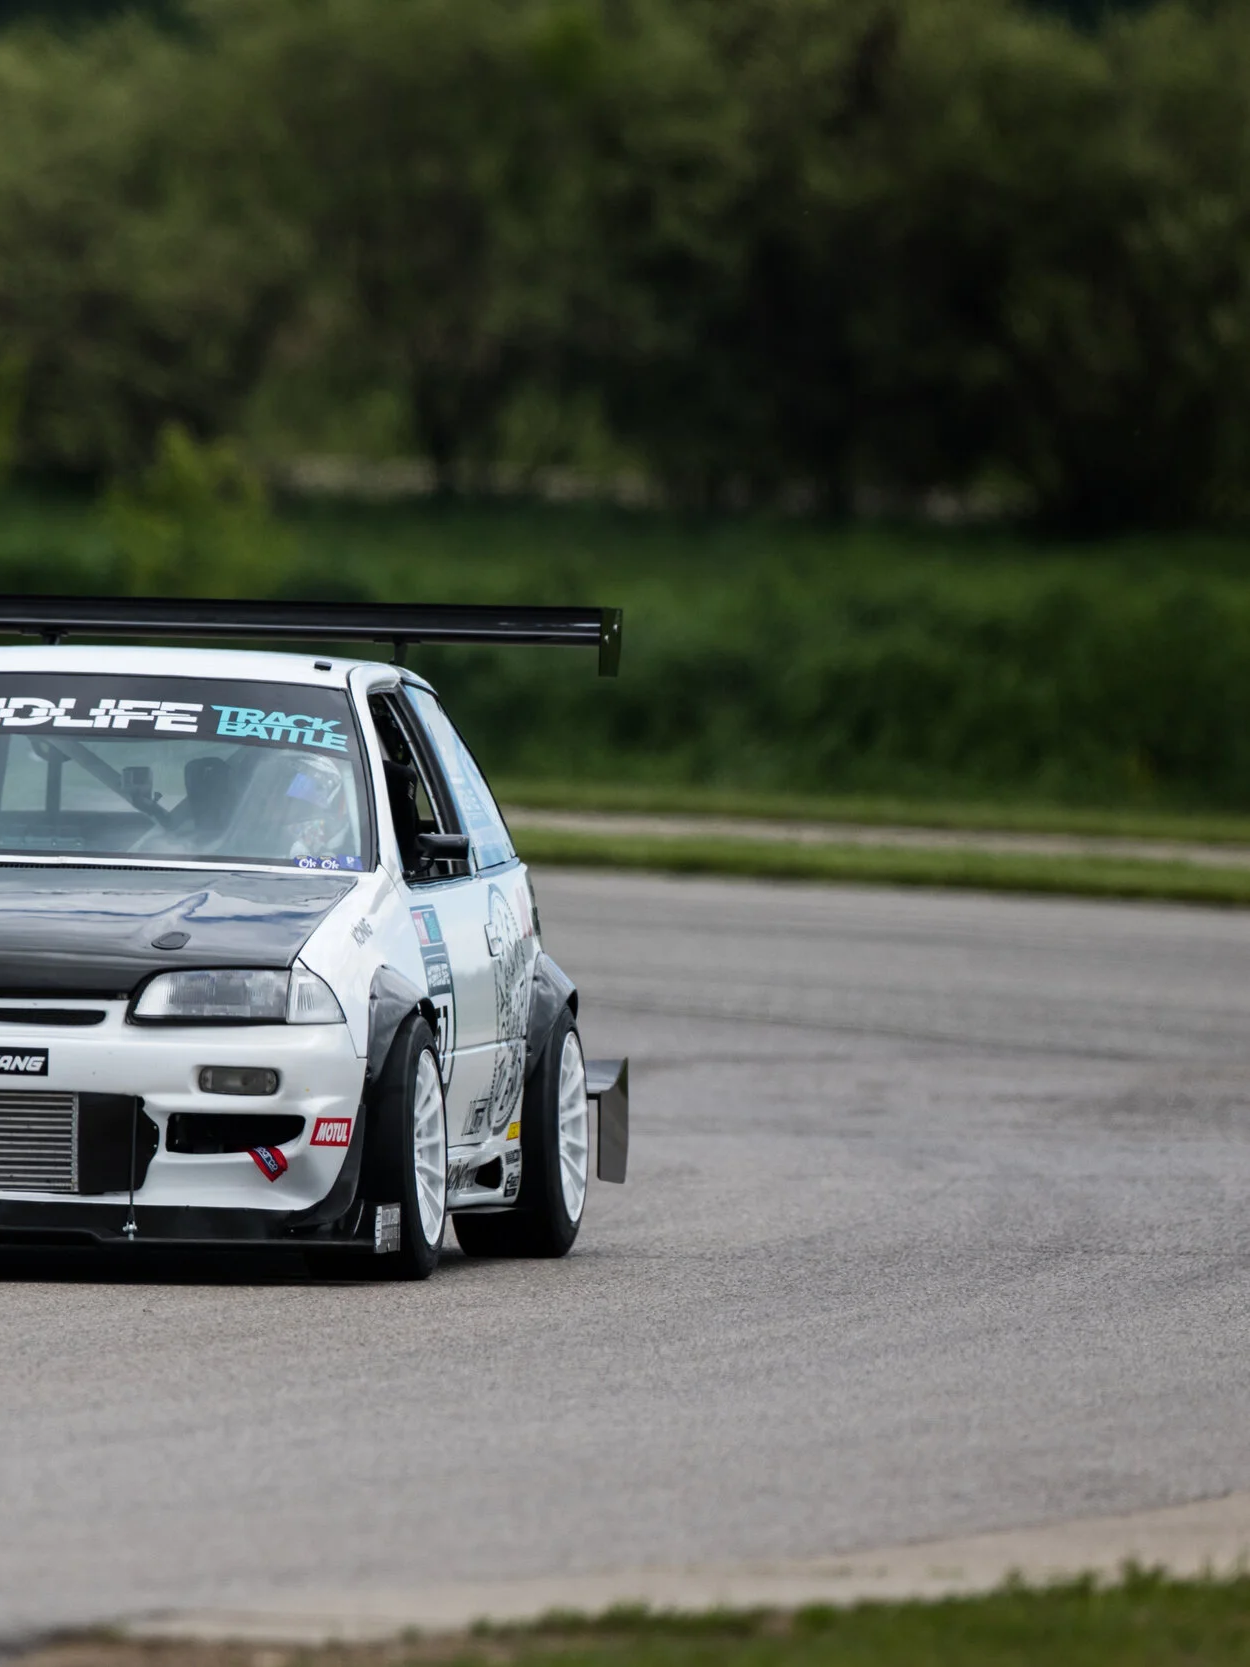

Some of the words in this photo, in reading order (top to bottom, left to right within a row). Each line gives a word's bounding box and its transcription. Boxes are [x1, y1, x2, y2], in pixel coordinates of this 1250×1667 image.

[210, 704, 342, 732] TRACK
[216, 721, 349, 753] BATTLE
[314, 1122, 349, 1143] MOTUL
